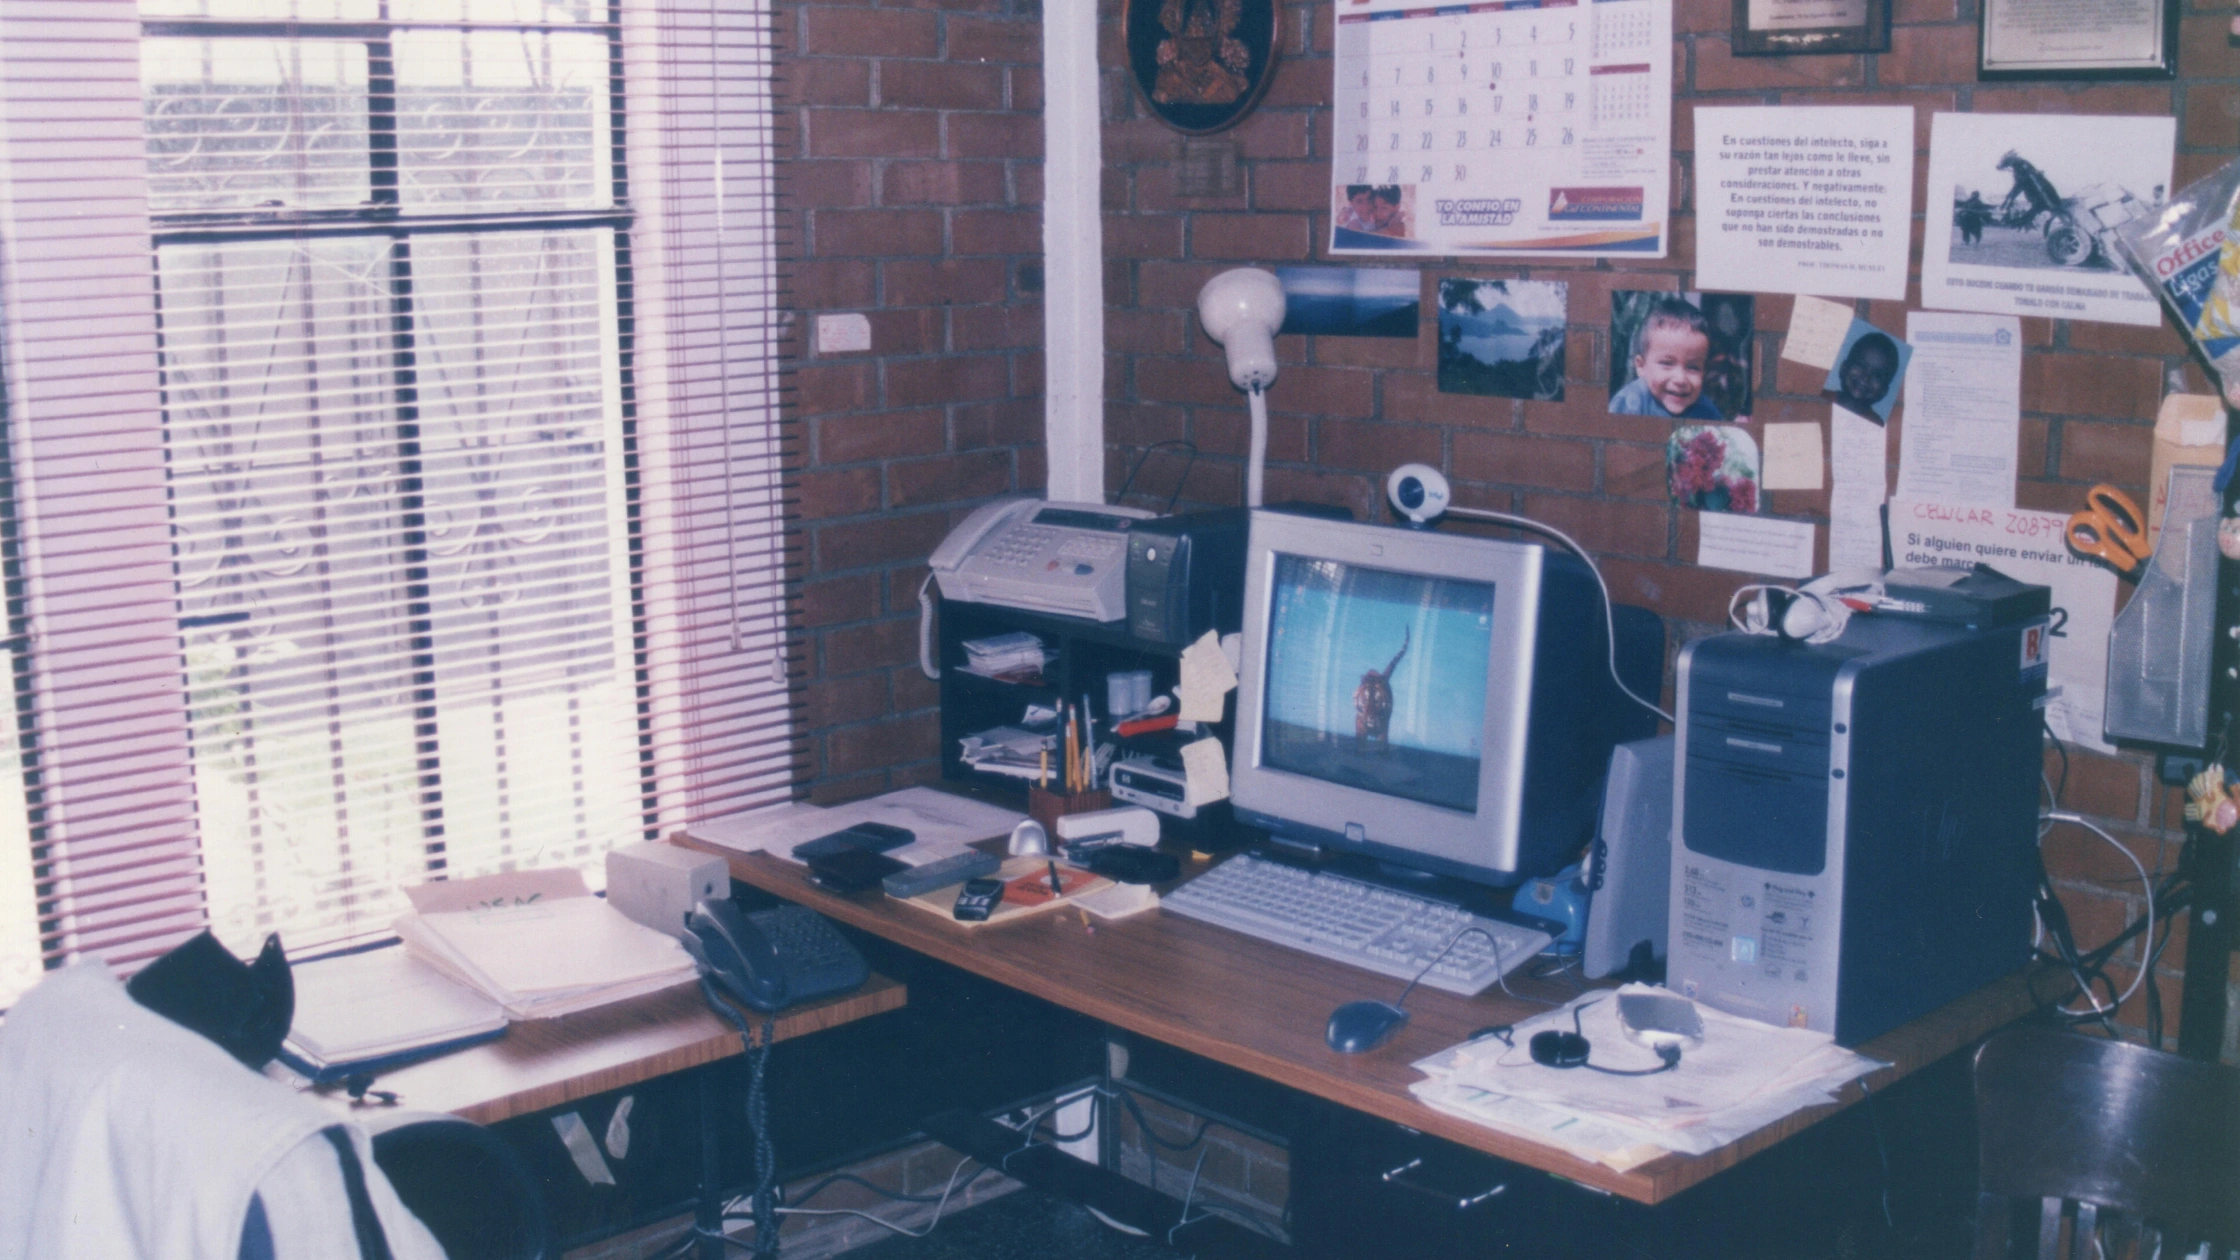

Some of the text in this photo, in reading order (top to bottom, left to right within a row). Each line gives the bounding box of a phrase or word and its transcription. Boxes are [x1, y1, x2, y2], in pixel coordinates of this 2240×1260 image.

[1429, 23, 1574, 50] 1 2 3 4 5
[1363, 70, 1368, 86] 6
[1395, 68, 1400, 84] 7
[1428, 67, 1433, 82] 8
[1461, 64, 1466, 80] 9
[1491, 62, 1501, 78] 10
[1530, 61, 1537, 77] 11
[1564, 59, 1574, 75] 12
[1361, 93, 1574, 118] 13 14 15 16 17 18 19
[1357, 135, 1368, 151] 20
[1391, 133, 1399, 149] 21
[1422, 132, 1432, 148] 22
[1457, 131, 1466, 147] 23
[1490, 130, 1501, 146] 24
[1526, 129, 1537, 145] 25
[1562, 128, 1573, 144] 26
[1723, 135, 1887, 149] En cuestiones del intelecto, siga a
[1720, 150, 1890, 165] su razón tan lejos como le lleve, sin
[1357, 165, 1466, 183] 27 28 29 30
[1748, 167, 1781, 176] prestar
[1784, 167, 1824, 176] atención
[1836, 169, 1861, 178] otras
[1721, 180, 1799, 190] consideraciones.
[1803, 181, 1809, 190] Y
[1436, 199, 1520, 212] YO CONFIO EN
[1731, 193, 1744, 202] En
[1747, 194, 1795, 204] cuestiones
[1799, 196, 1812, 205] del
[1815, 196, 1861, 208] intelecto,
[1441, 213, 1512, 225] LA AMISTAD
[1726, 209, 1880, 223] suponga ciertas las conclusiones
[1722, 223, 1738, 232] que
[1742, 223, 1752, 231] no
[1757, 223, 1773, 232] han
[1776, 223, 1794, 234] sido
[1797, 225, 1858, 236] demostradas
[1871, 229, 1883, 237] no
[1758, 238, 1842, 251] son demostrables.
[2157, 229, 2225, 275] Office
[2169, 260, 2218, 297] Ligas
[1908, 533, 1920, 545] Si
[1924, 536, 1971, 552] alguien
[1976, 544, 2017, 558] quiere
[2021, 547, 2063, 563] enviar
[1906, 551, 1938, 565] debe
